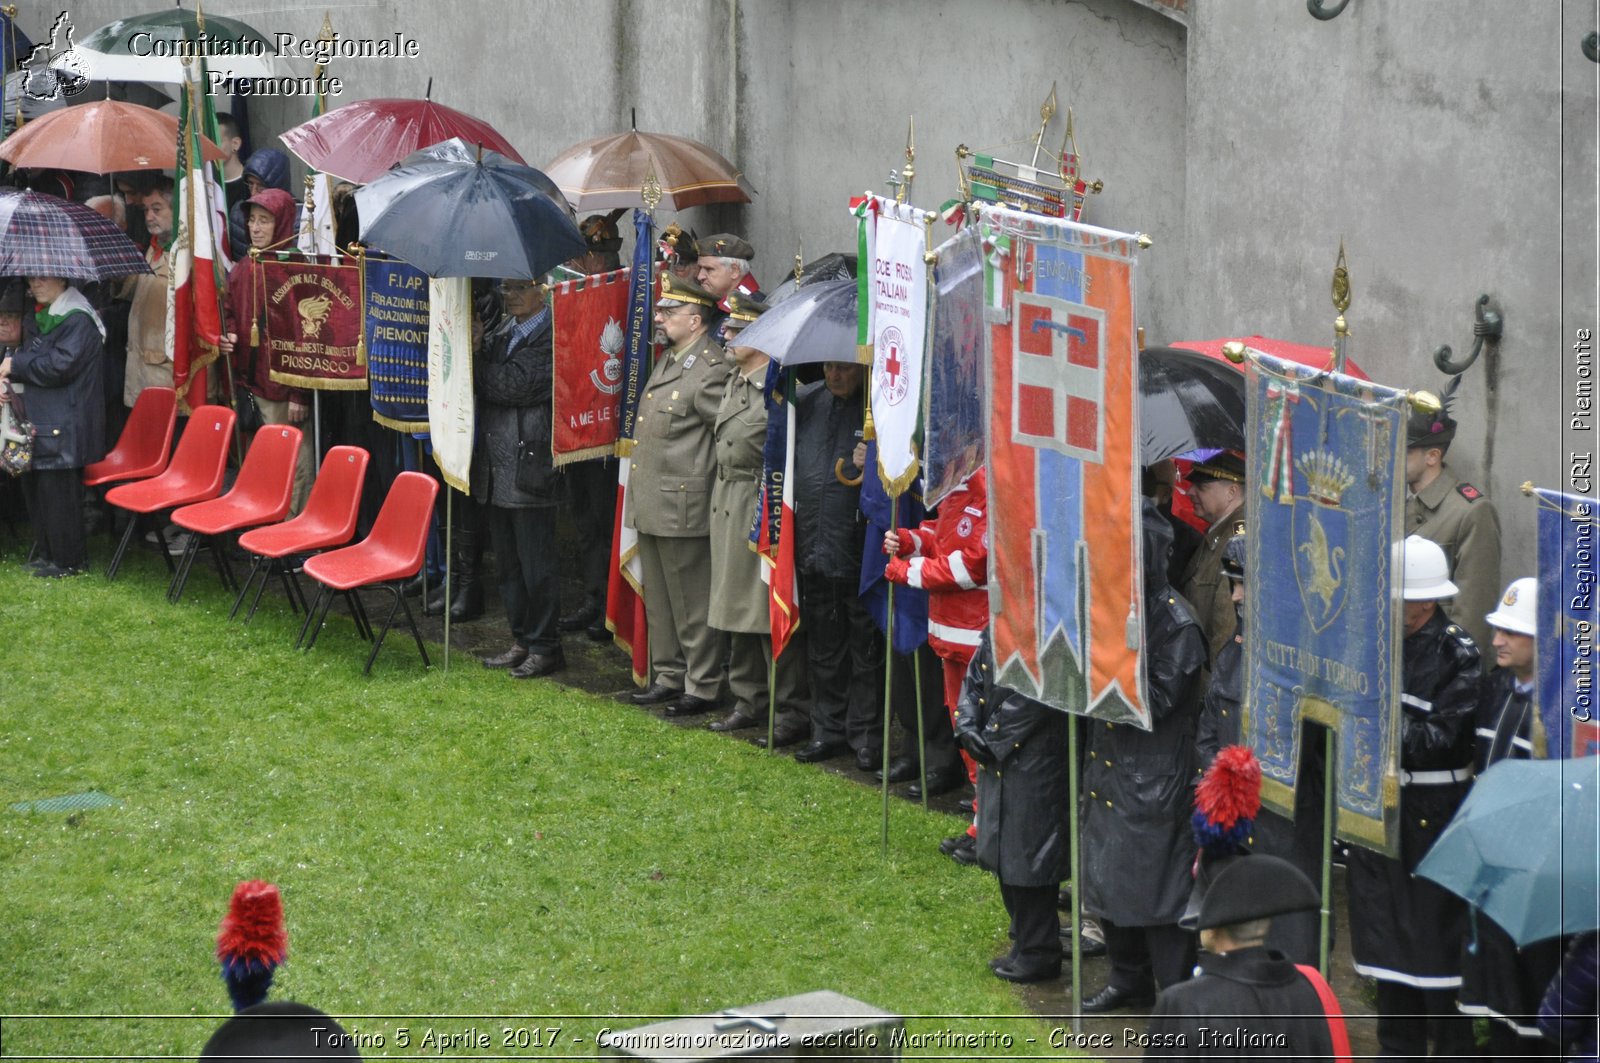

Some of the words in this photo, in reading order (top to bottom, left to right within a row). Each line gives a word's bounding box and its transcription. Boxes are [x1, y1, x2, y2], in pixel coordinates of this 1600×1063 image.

[1024, 259, 1093, 295] PIEMONTE
[271, 339, 296, 351] SEZIONE
[375, 326, 429, 344] PIEMONT
[281, 354, 350, 374] PIOSSASCO
[626, 357, 640, 404] FERREIRA
[570, 415, 577, 428] A
[579, 410, 594, 426] ME
[597, 407, 610, 421] LE
[771, 471, 784, 541] TORINO
[1323, 657, 1369, 696] TORINO
